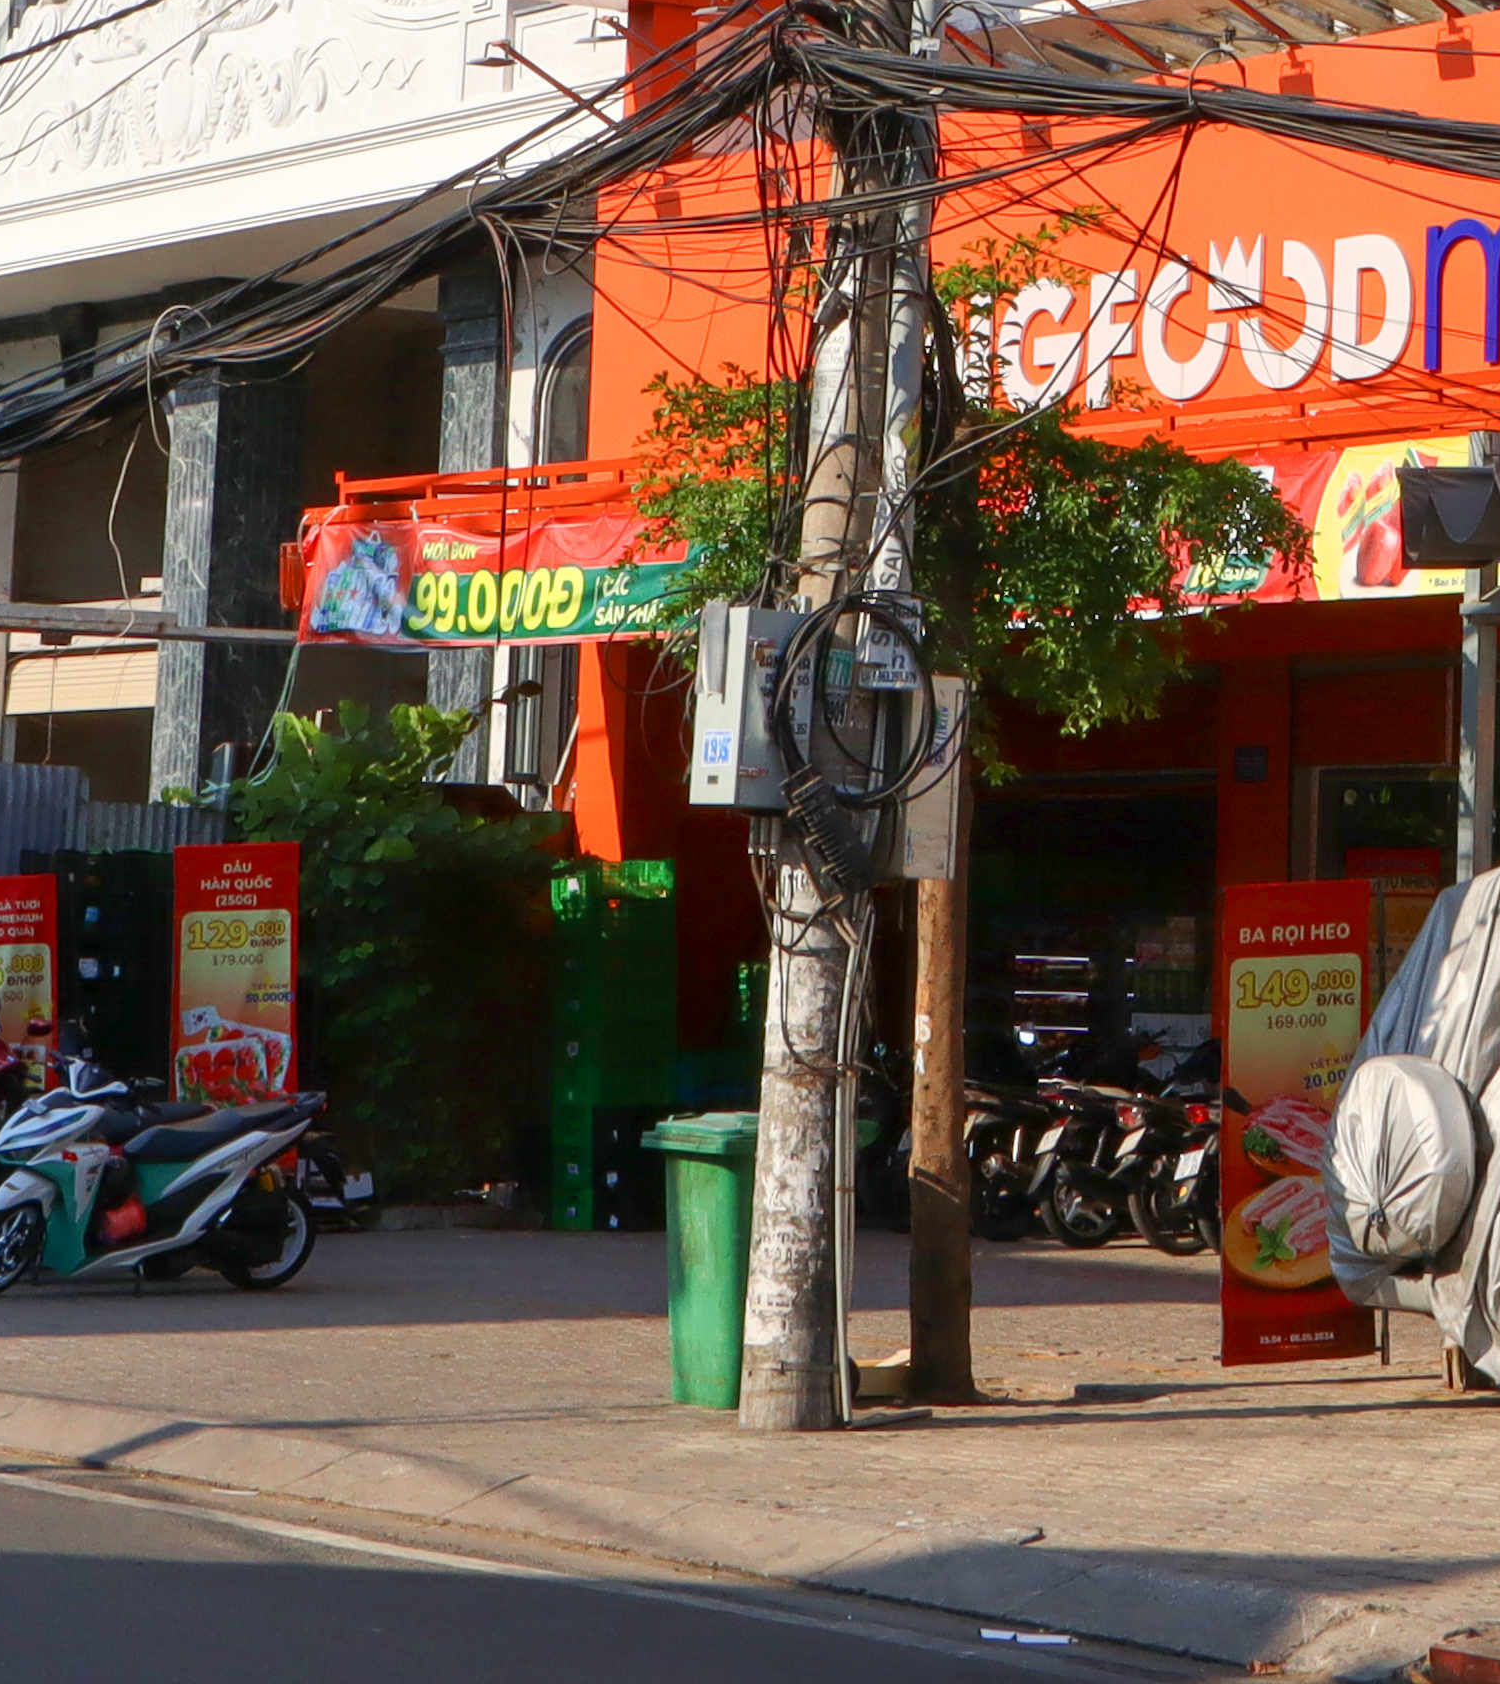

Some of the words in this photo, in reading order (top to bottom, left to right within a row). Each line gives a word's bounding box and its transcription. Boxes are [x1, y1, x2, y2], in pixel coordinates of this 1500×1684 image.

[200, 877, 230, 890] HÀN
[234, 874, 272, 891] QUỐC
[215, 894, 257, 908] (250G)
[1239, 927, 1265, 944] BA
[1272, 924, 1304, 946] RỌI
[1311, 923, 1350, 941] HEO
[1316, 992, 1355, 1006] Đ/KG
[1266, 1013, 1327, 1029] 169.000
[1304, 1069, 1347, 1090] 20.00
